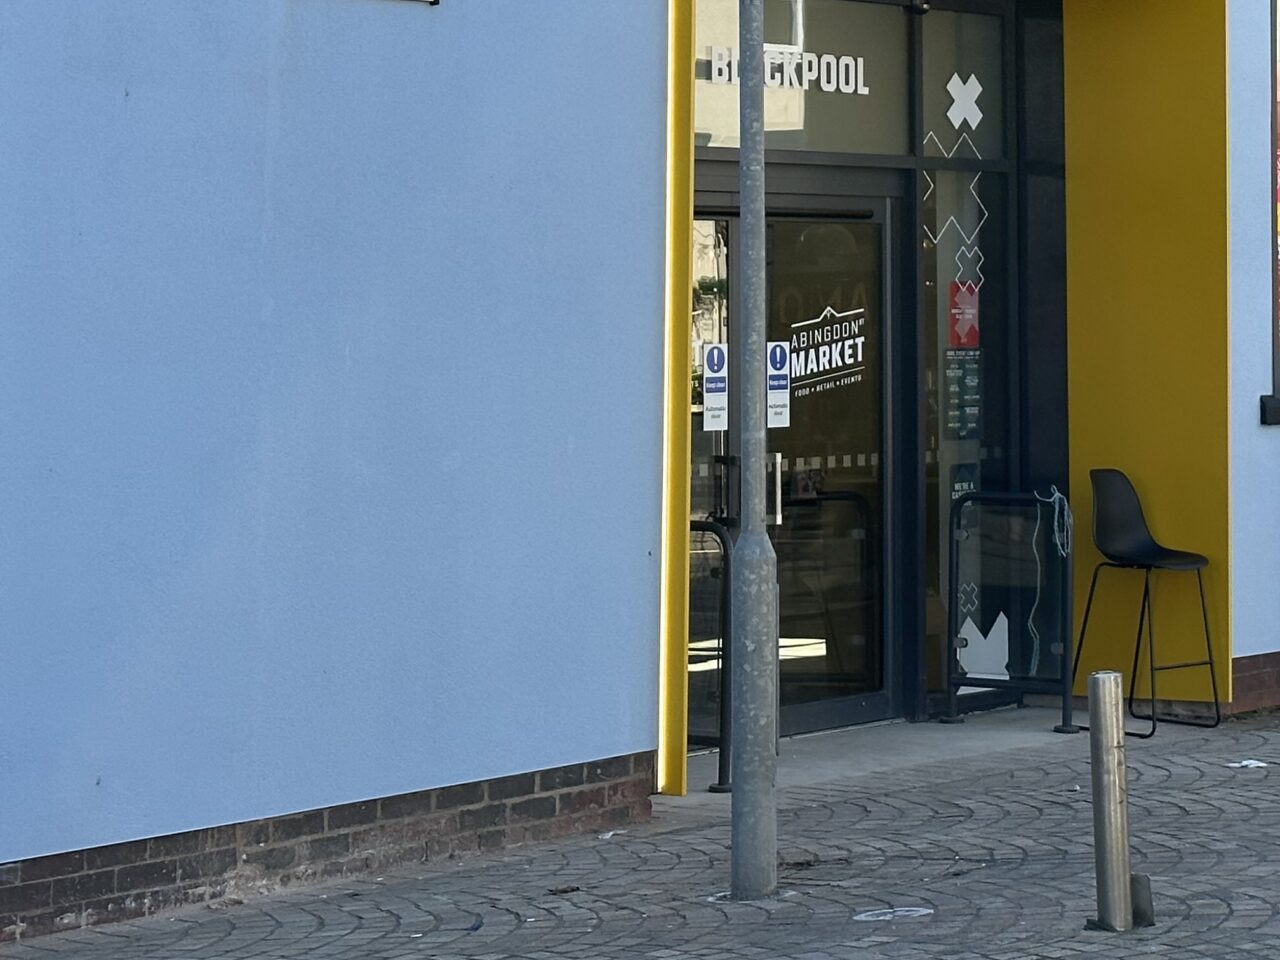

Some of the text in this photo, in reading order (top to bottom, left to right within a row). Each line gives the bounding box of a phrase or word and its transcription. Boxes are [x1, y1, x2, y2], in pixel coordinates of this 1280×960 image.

[710, 45, 870, 95] BLCKPOOL
[791, 319, 859, 350] ABINGDON
[791, 336, 865, 378] MARKET
[840, 374, 862, 386] EVENTS
